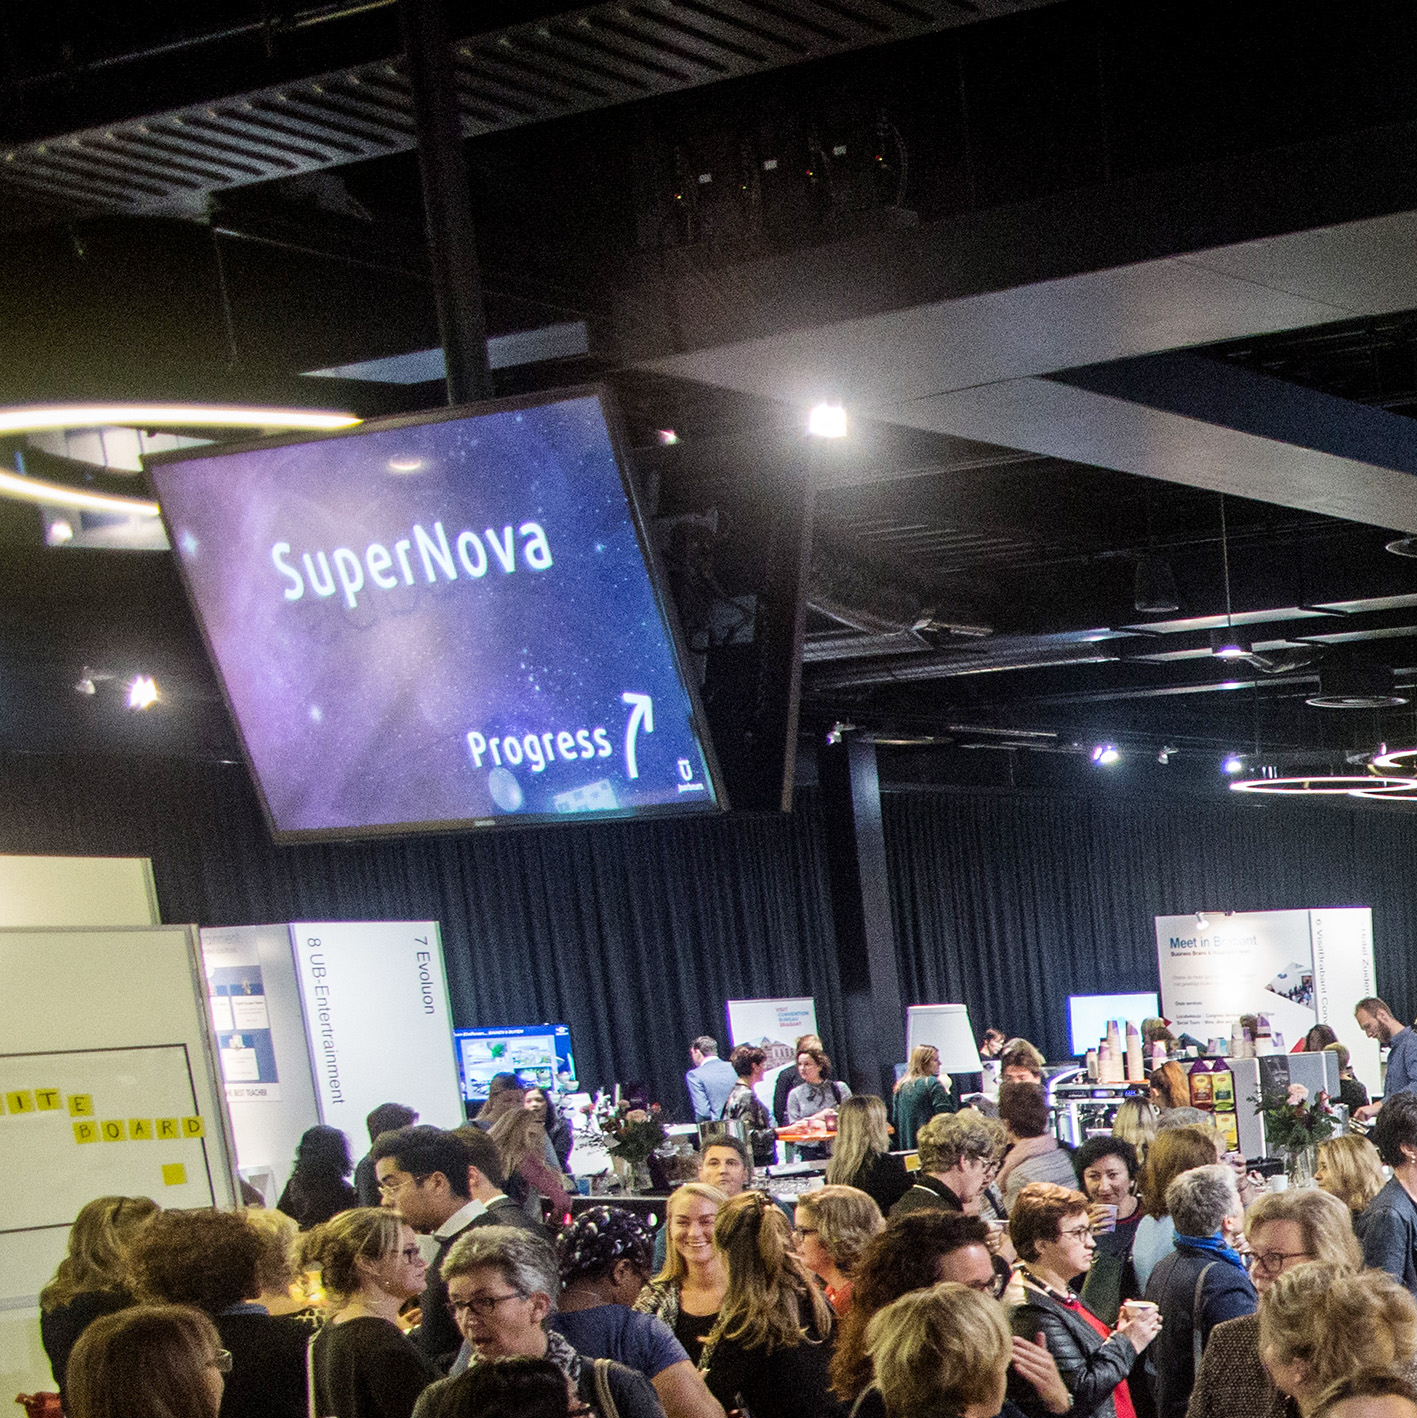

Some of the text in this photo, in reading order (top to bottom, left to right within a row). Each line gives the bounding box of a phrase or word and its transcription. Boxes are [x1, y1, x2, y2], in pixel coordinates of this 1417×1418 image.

[270, 520, 554, 609] SuperNova
[466, 727, 613, 773] Progress
[1169, 936, 1197, 949] Meet
[1200, 936, 1210, 947] in
[414, 936, 435, 1015] 7 Evoluon
[307, 937, 346, 1105] 8 UB-Entertrainment
[79, 1119, 201, 1139] BOARD
